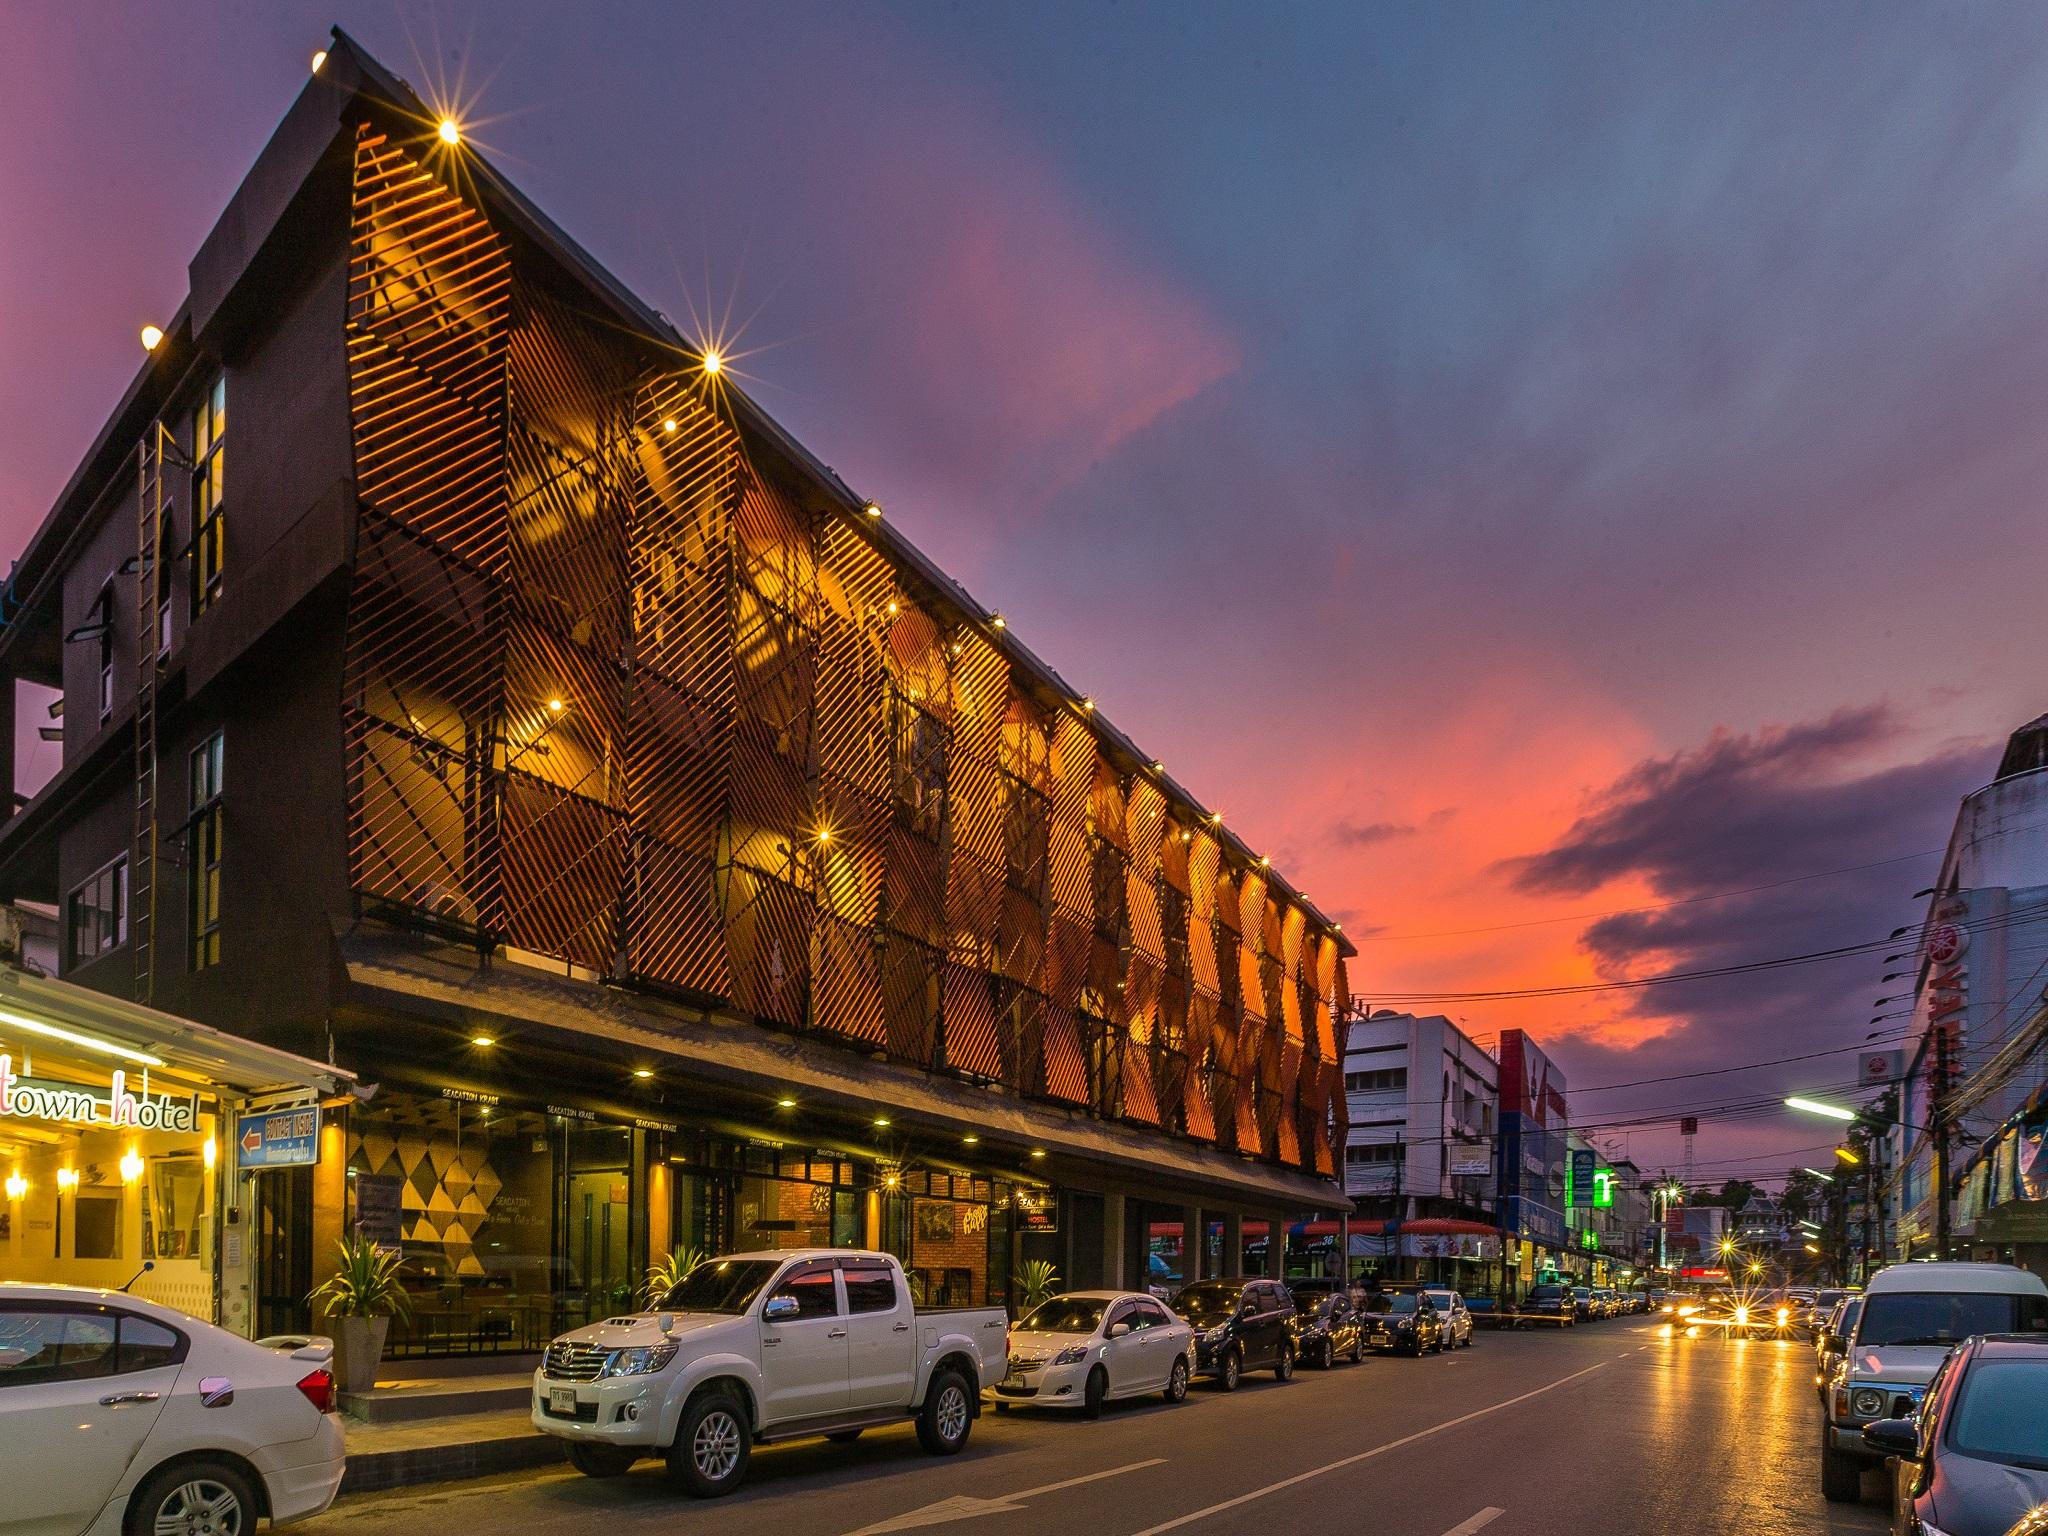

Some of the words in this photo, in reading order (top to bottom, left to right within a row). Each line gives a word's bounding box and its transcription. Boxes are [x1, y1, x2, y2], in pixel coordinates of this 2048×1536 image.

[0, 1054, 97, 1122] town
[112, 1070, 201, 1132] hotel
[442, 1088, 477, 1102] SEACATION
[479, 1093, 499, 1105] KRABI
[547, 1104, 577, 1117] SEACATION
[578, 1108, 595, 1120] KRABI
[265, 1116, 293, 1141] CONTACT
